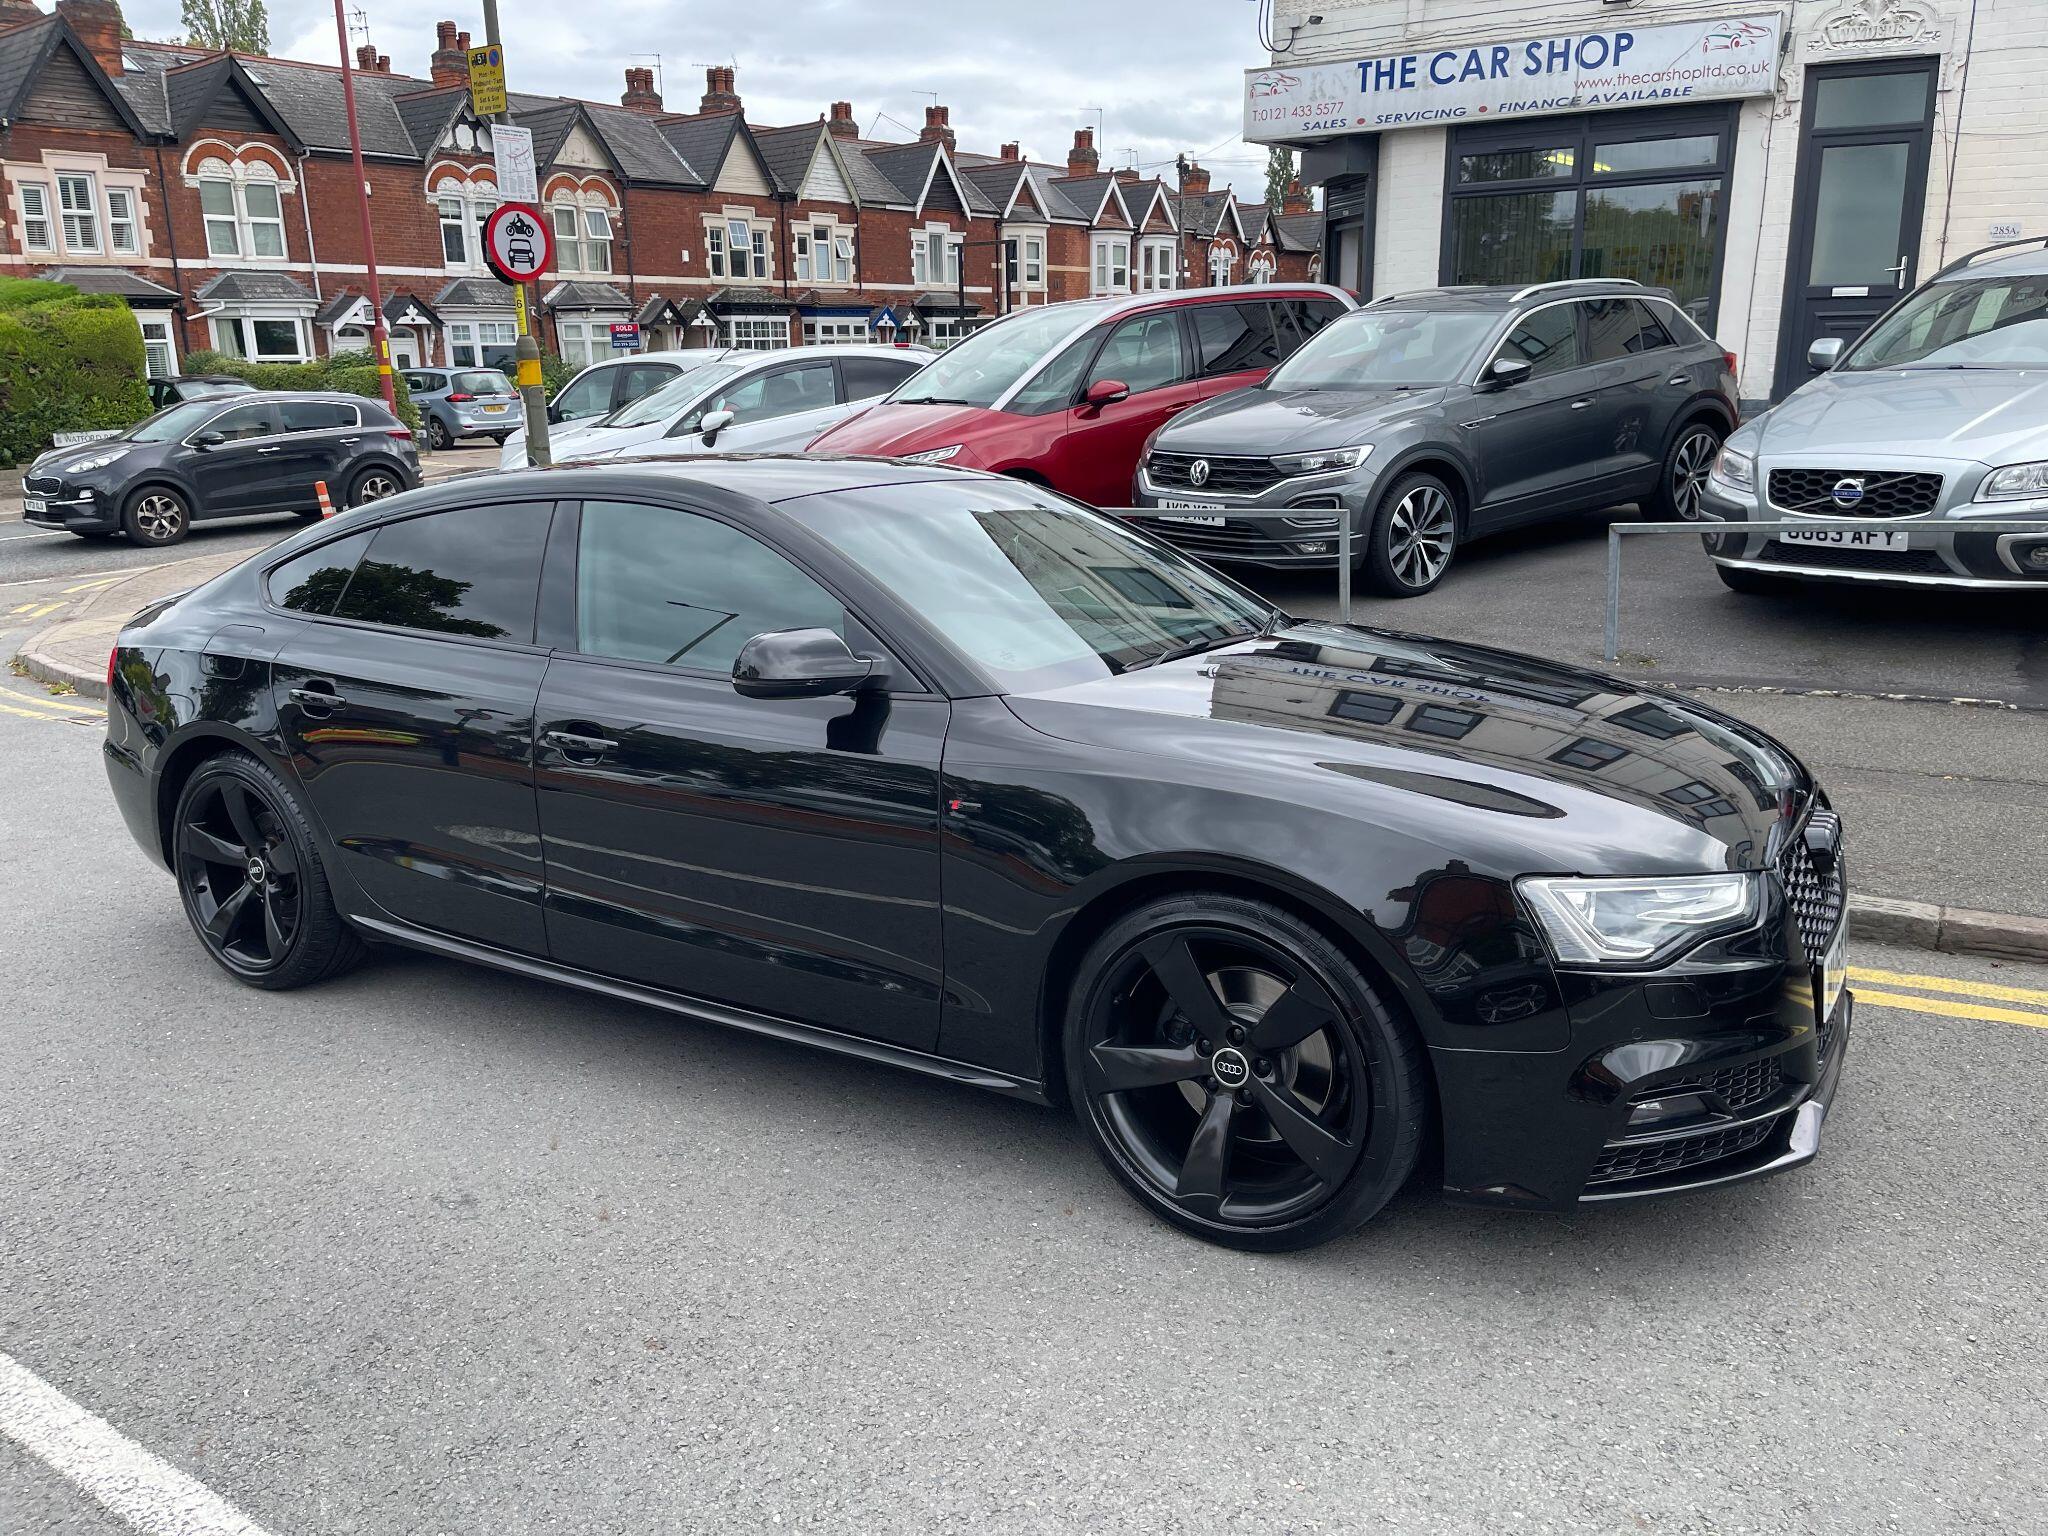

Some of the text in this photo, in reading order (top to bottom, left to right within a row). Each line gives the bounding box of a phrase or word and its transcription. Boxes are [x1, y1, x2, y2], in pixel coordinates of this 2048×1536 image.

[1358, 32, 1634, 93] THE CAR SHOP
[1573, 60, 1770, 90] www.thecarshopltd.co.uk
[1291, 105, 1312, 118] 433
[1316, 102, 1344, 116] 5577
[1302, 86, 1693, 131] SALES SERVICING FINANCE AVAILABLE
[1993, 225, 2017, 235] 285A
[64, 434, 102, 443] WATFORD
